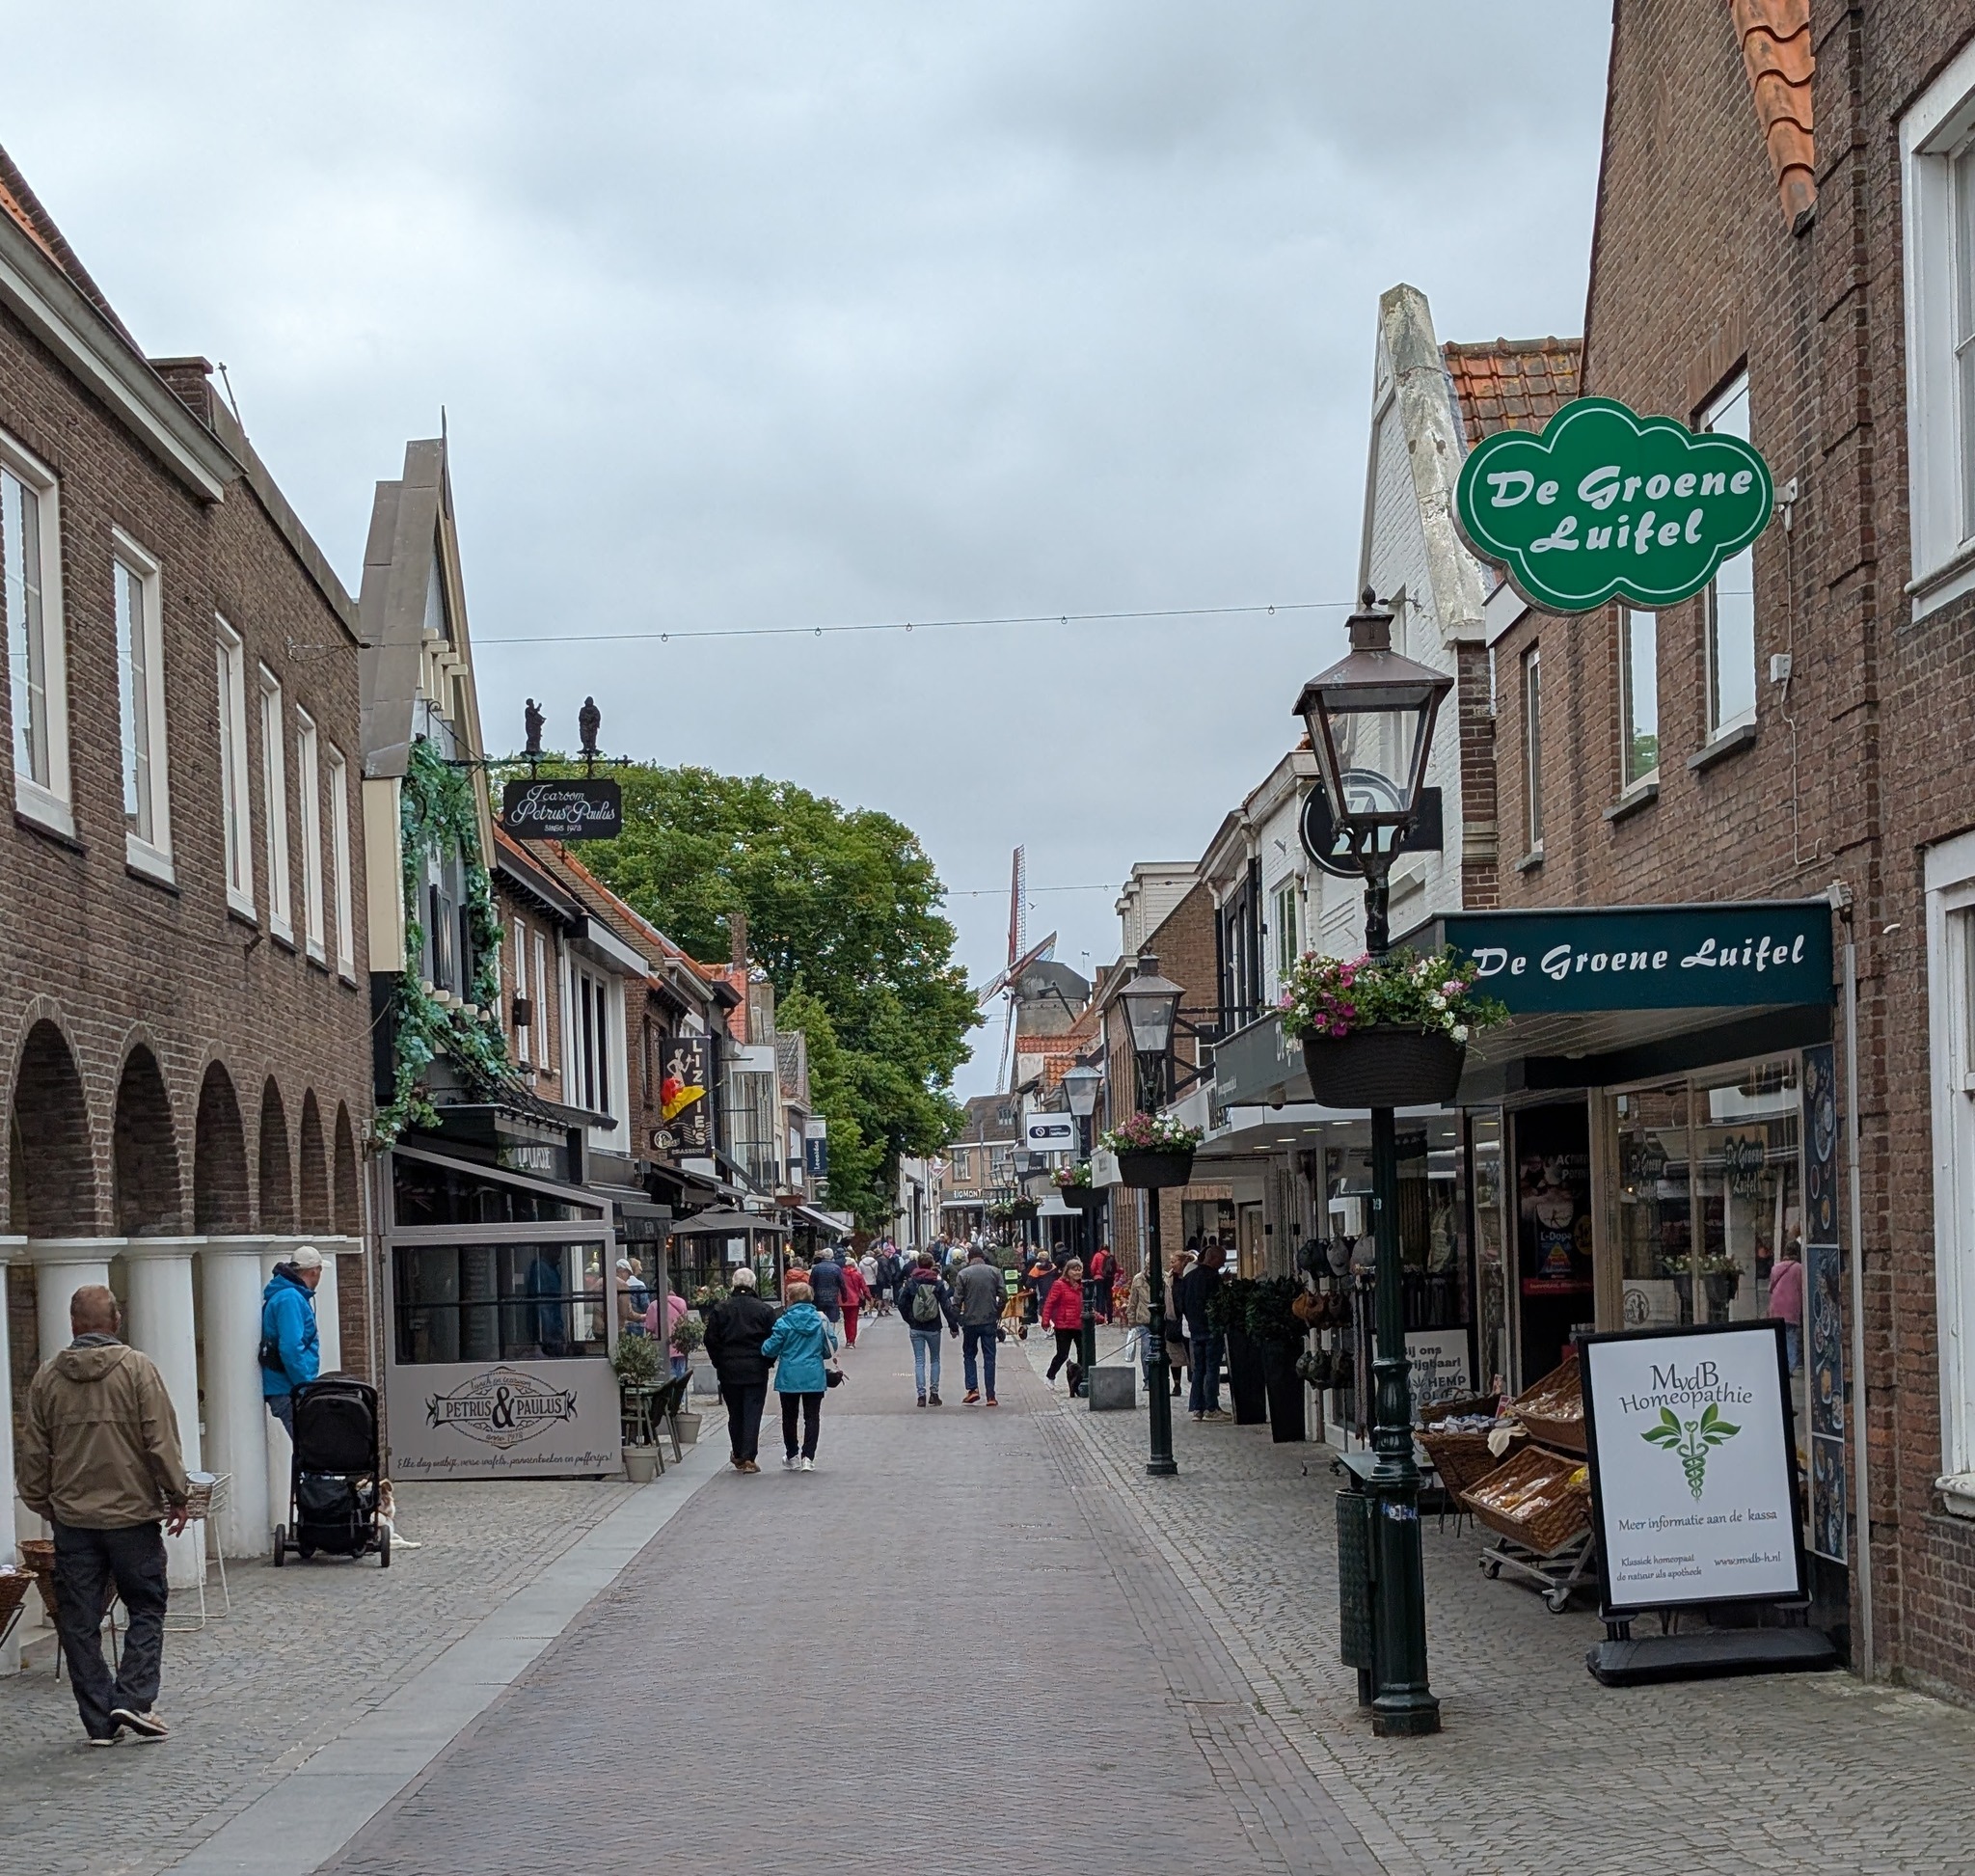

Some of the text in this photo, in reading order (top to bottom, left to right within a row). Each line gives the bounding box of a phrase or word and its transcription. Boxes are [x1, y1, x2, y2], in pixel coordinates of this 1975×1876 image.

[1486, 465, 1753, 510] De Groene
[1529, 508, 1704, 555] Luifel
[527, 783, 585, 802] Tearoom
[510, 799, 567, 824] Petrus
[566, 801, 615, 824] Paulus
[1472, 934, 1804, 981] De Groene Luifel
[691, 1039, 707, 1146] LIZIE'S
[1419, 1346, 1443, 1355] ons
[1427, 1375, 1467, 1388] HEMP
[1649, 1361, 1719, 1391] MvdB
[446, 1386, 562, 1429] PETRUS & PAULUS
[1619, 1382, 1752, 1414] Homeopathie
[1618, 1509, 1777, 1532] Meer informatie aan de kassa
